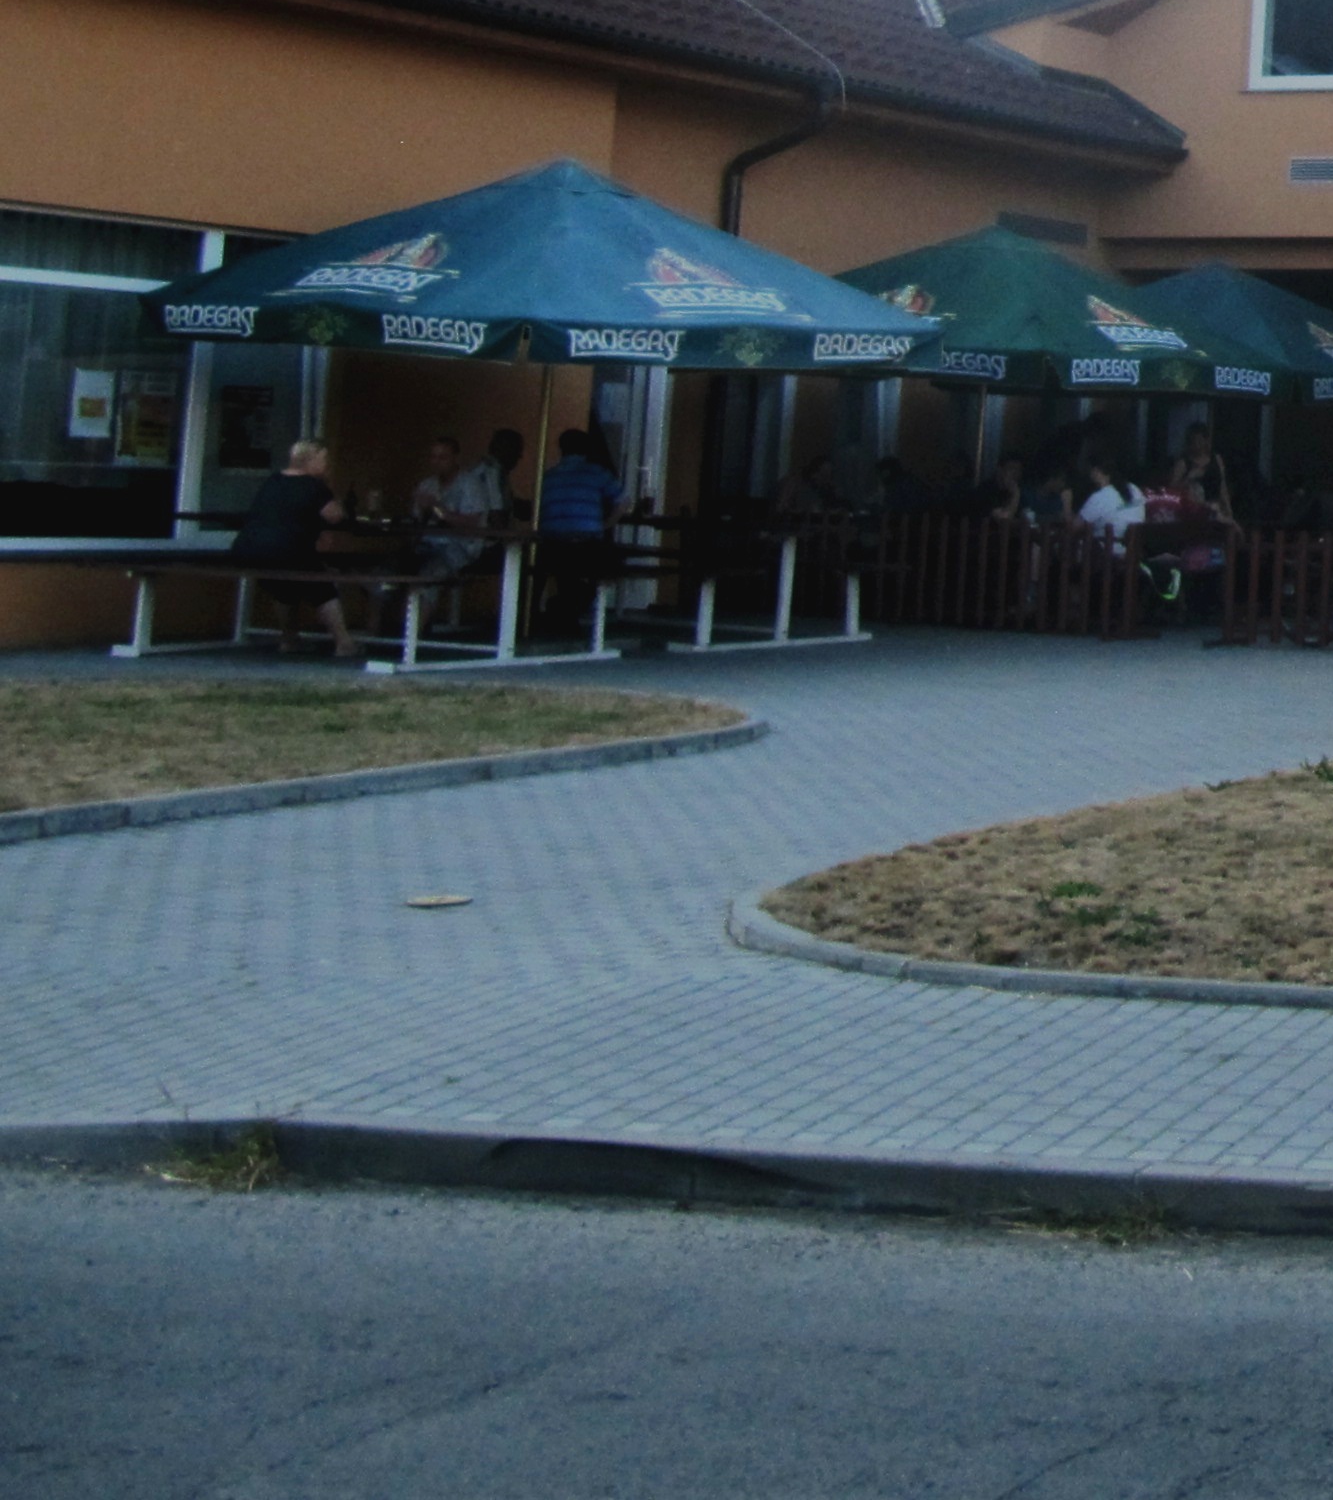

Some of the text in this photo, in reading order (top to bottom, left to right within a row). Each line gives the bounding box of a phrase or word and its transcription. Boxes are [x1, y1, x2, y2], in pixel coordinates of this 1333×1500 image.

[295, 267, 443, 292] RADEGAST
[164, 305, 260, 337] RADEGAST
[382, 314, 488, 354] RADEGAST
[568, 329, 687, 361] RADEGAST
[813, 333, 913, 361] RADEGAST
[941, 350, 1008, 380] DEGAST
[1071, 358, 1141, 385] RADEGAST
[1214, 366, 1272, 395] RADEGAST
